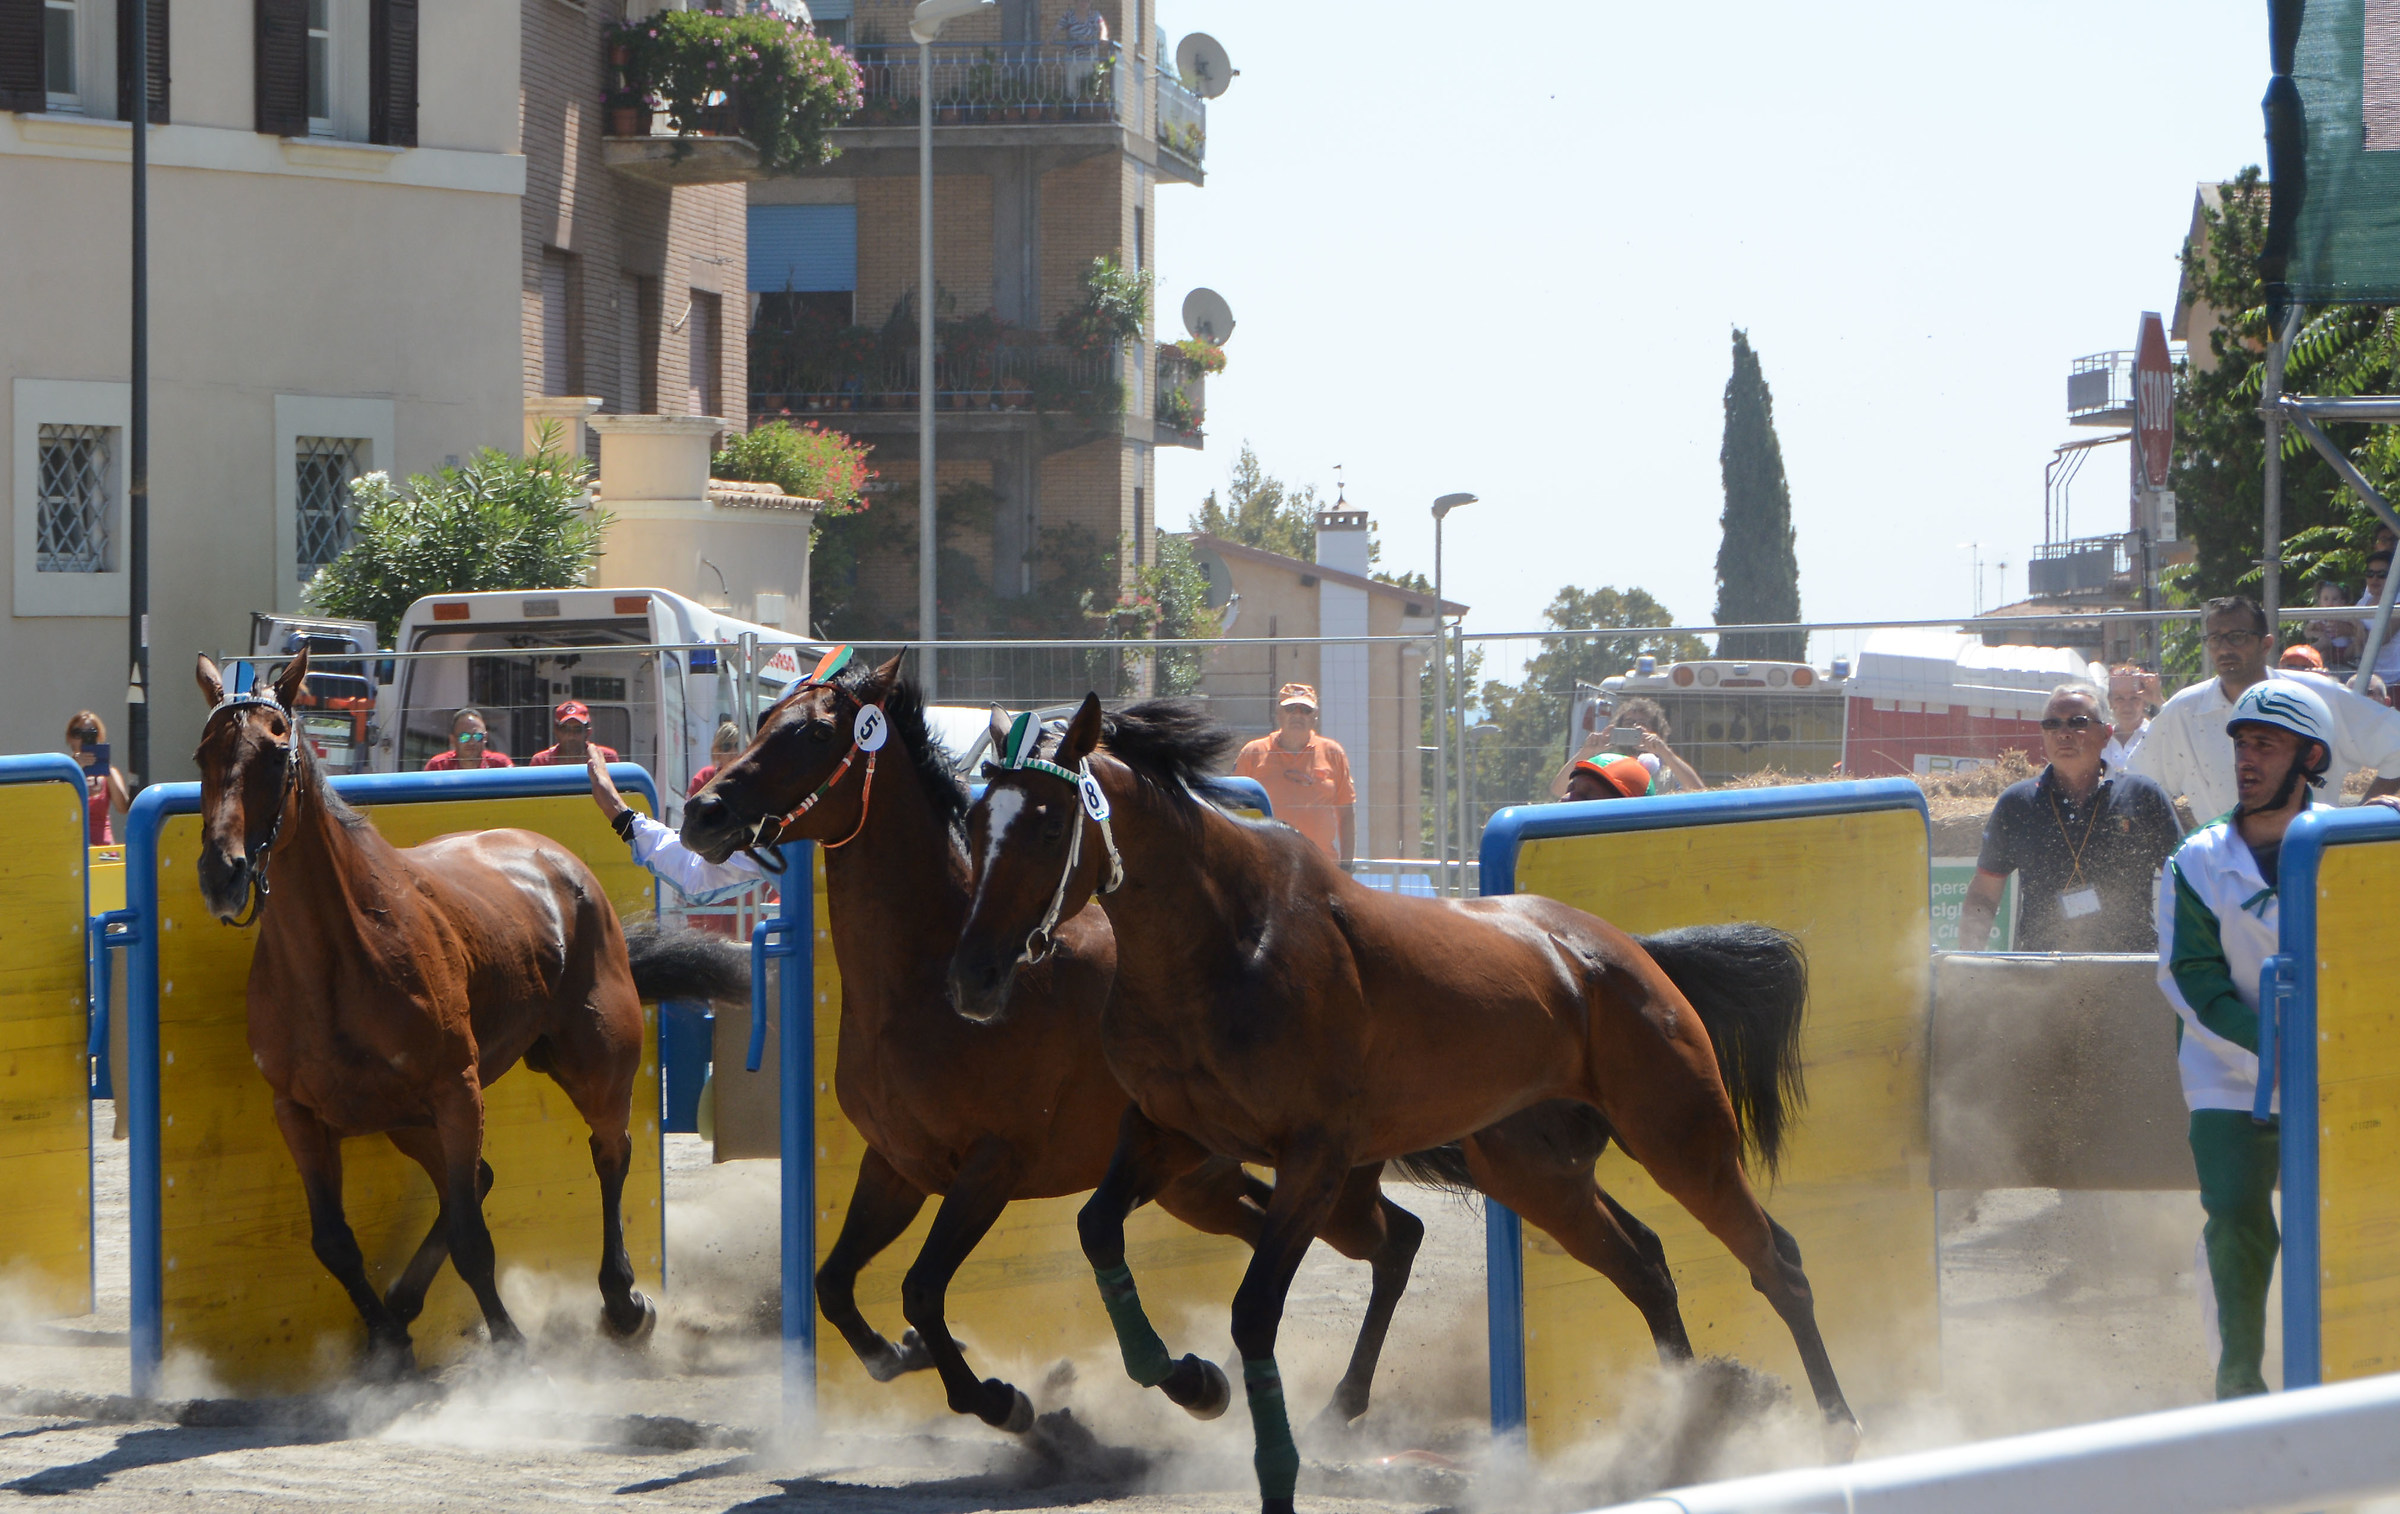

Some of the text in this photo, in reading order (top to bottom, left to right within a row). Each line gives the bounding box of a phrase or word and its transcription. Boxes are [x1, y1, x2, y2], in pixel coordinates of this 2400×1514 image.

[2140, 369, 2171, 431] STOP
[860, 714, 879, 741] 5
[1085, 781, 1100, 809] 8
